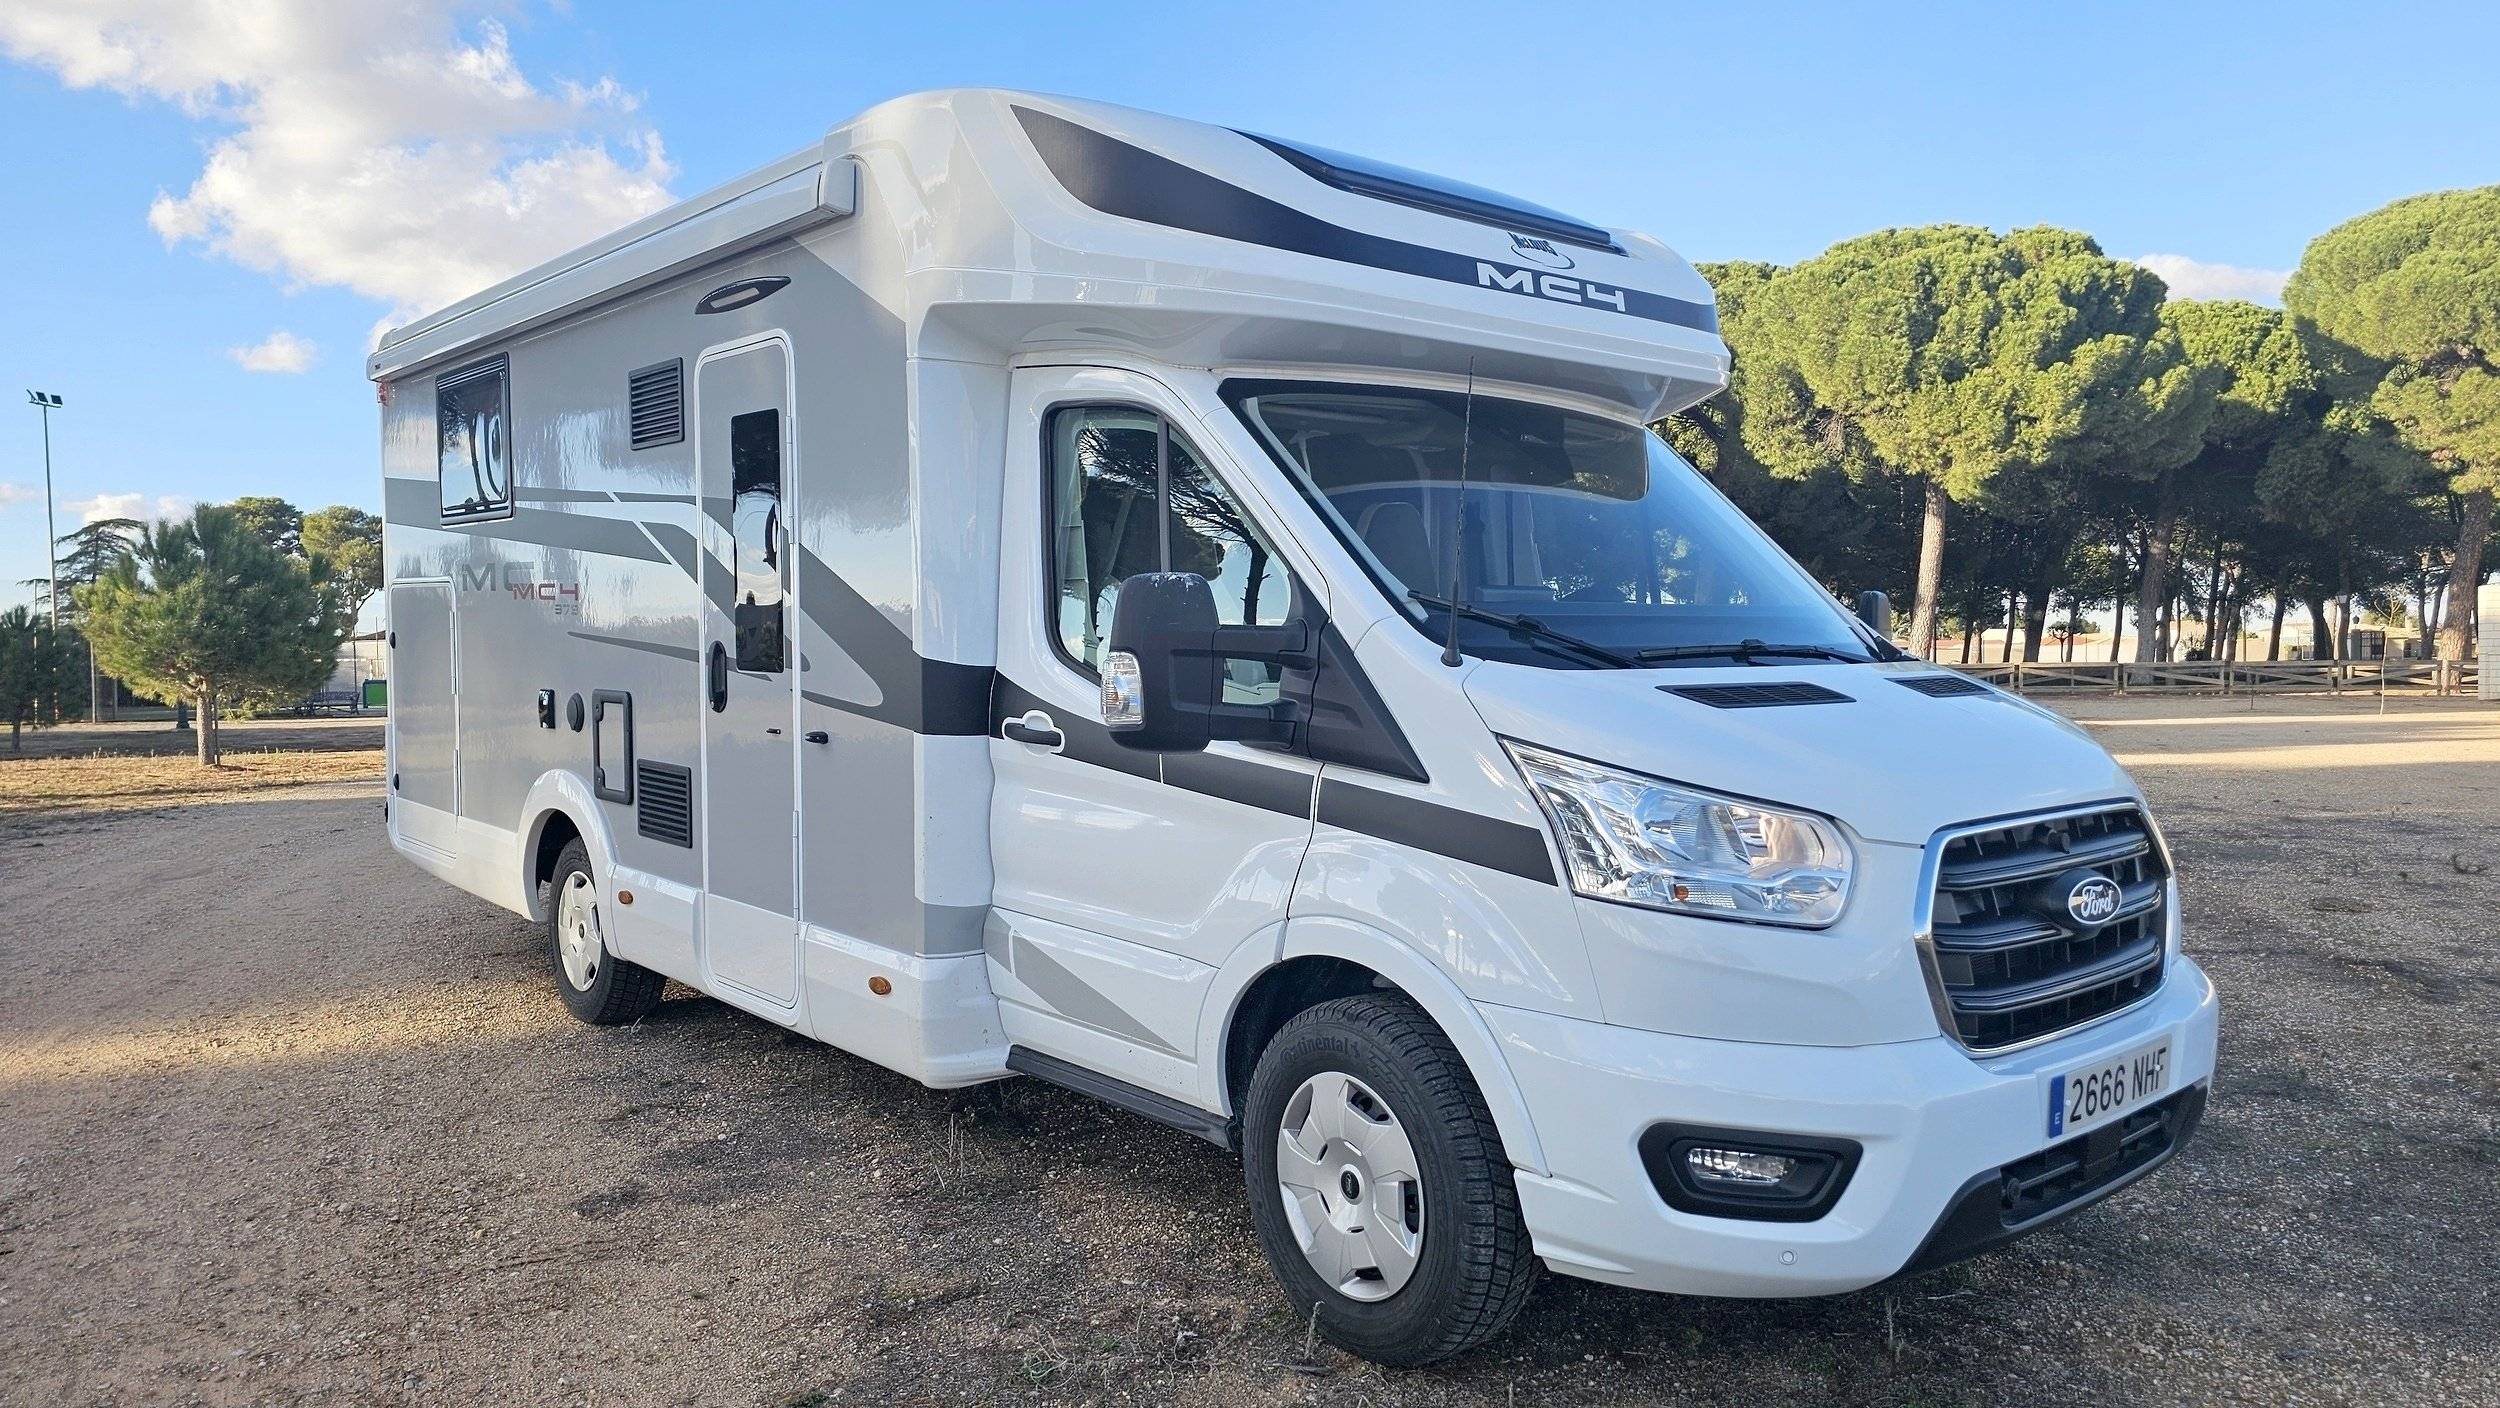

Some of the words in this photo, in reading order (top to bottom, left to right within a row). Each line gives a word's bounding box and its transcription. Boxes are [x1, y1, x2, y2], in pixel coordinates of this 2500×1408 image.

[1476, 261, 1627, 312] MC4
[512, 582, 579, 601] MC4
[2080, 884, 2114, 918] Ford
[2069, 1064, 2126, 1123] 2666
[2132, 1047, 2167, 1100] NHF
